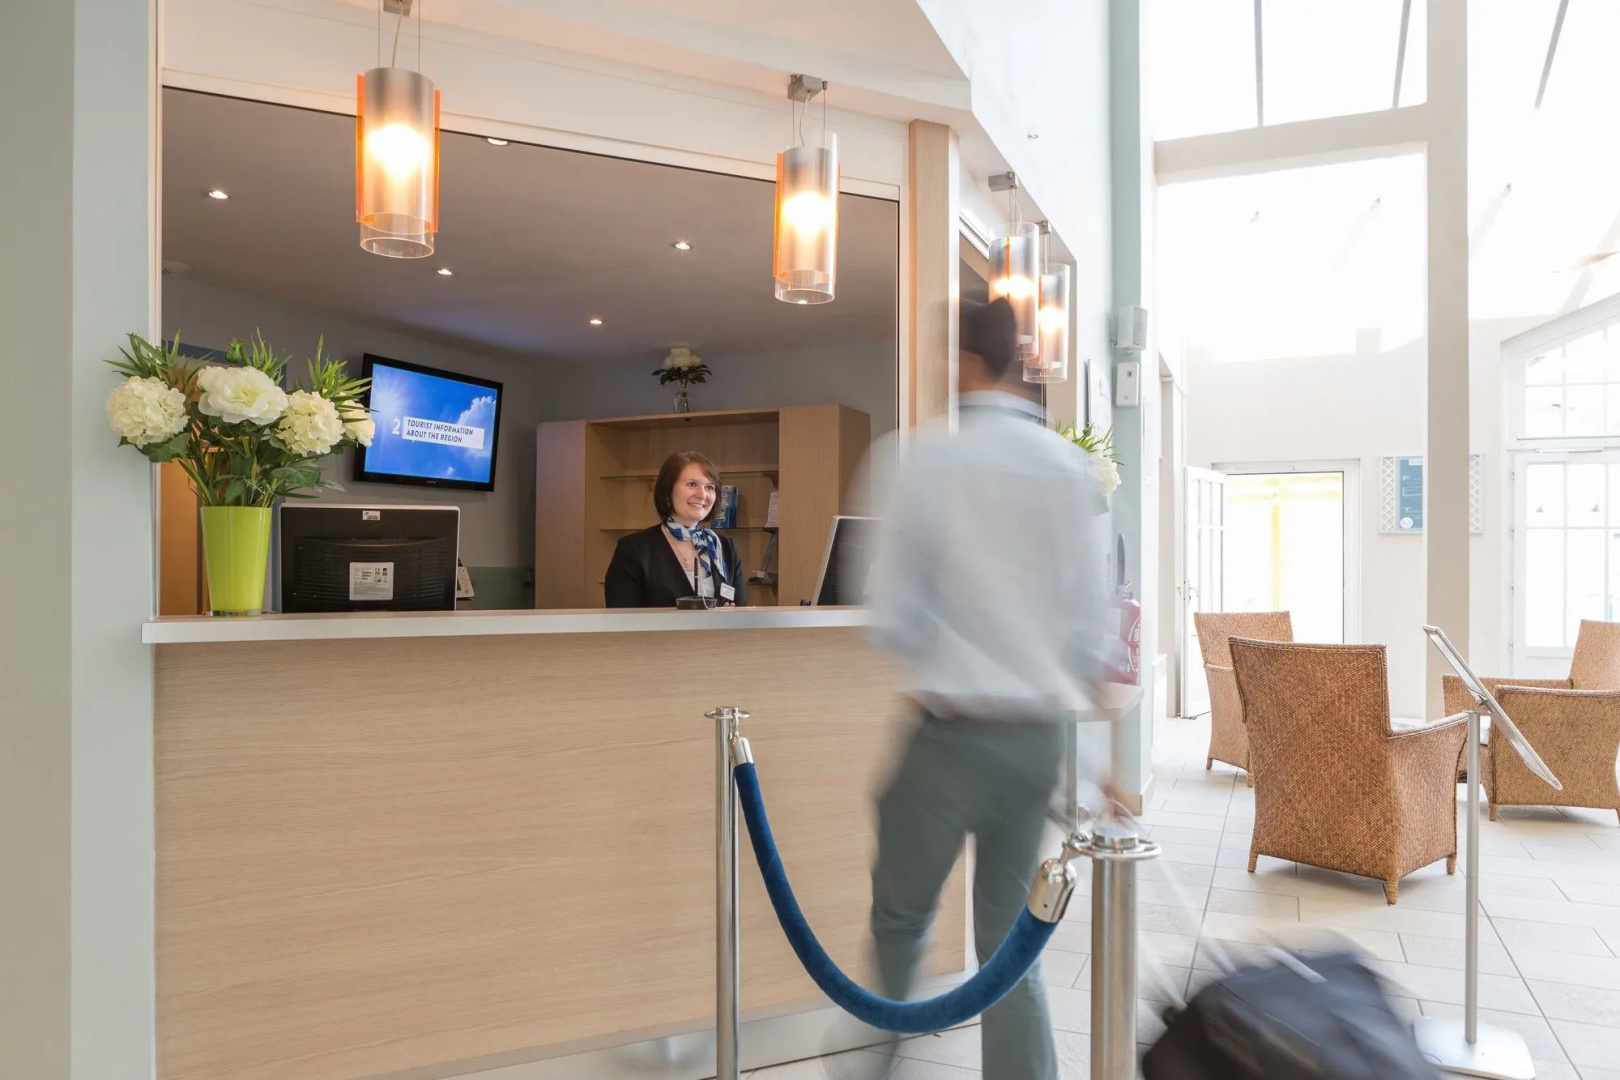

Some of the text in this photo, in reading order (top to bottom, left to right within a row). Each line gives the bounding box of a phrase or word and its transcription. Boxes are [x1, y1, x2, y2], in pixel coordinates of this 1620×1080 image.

[392, 418, 401, 435] 2
[407, 420, 473, 435] TOURIST INFORMATION
[406, 430, 463, 443] ABOUT THE REGION
